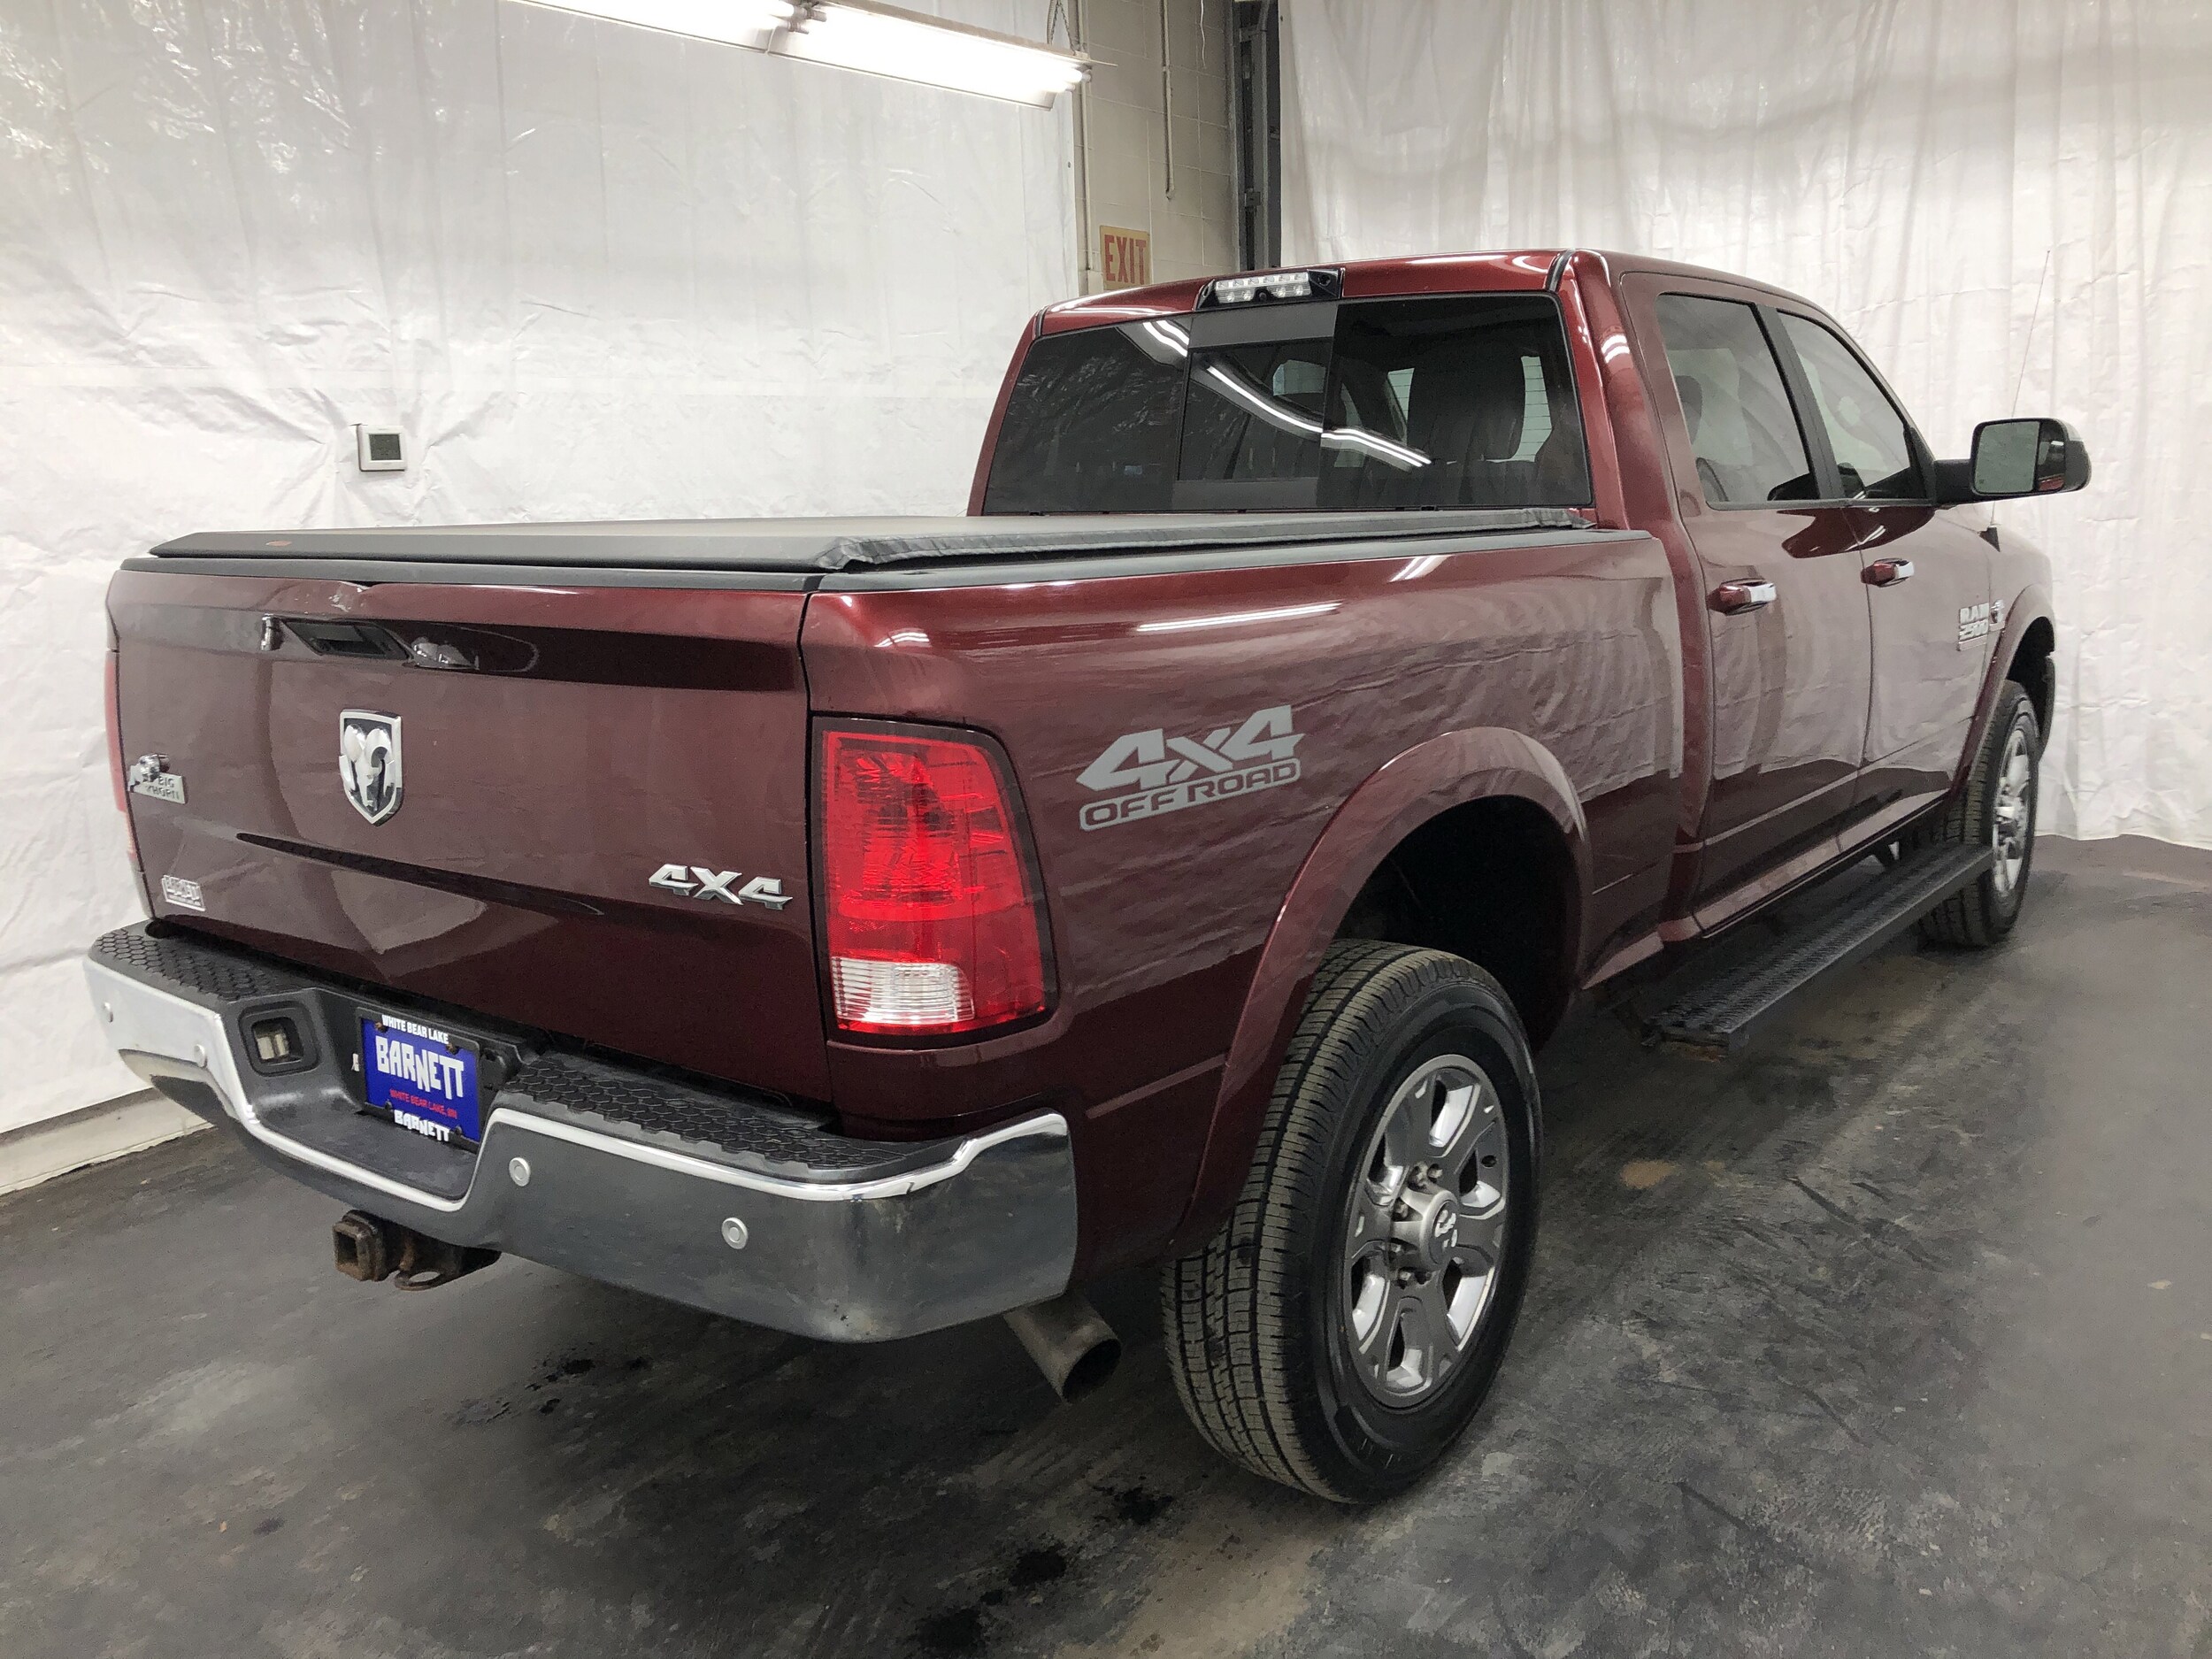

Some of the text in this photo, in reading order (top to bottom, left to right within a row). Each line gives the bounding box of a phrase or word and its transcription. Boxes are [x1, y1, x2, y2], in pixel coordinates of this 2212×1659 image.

[1103, 234, 1148, 285] EXIT
[381, 1014, 449, 1045] WHITE BEAR LAKE
[375, 1035, 465, 1100] BARNETT
[393, 1109, 451, 1142] BARNETT
